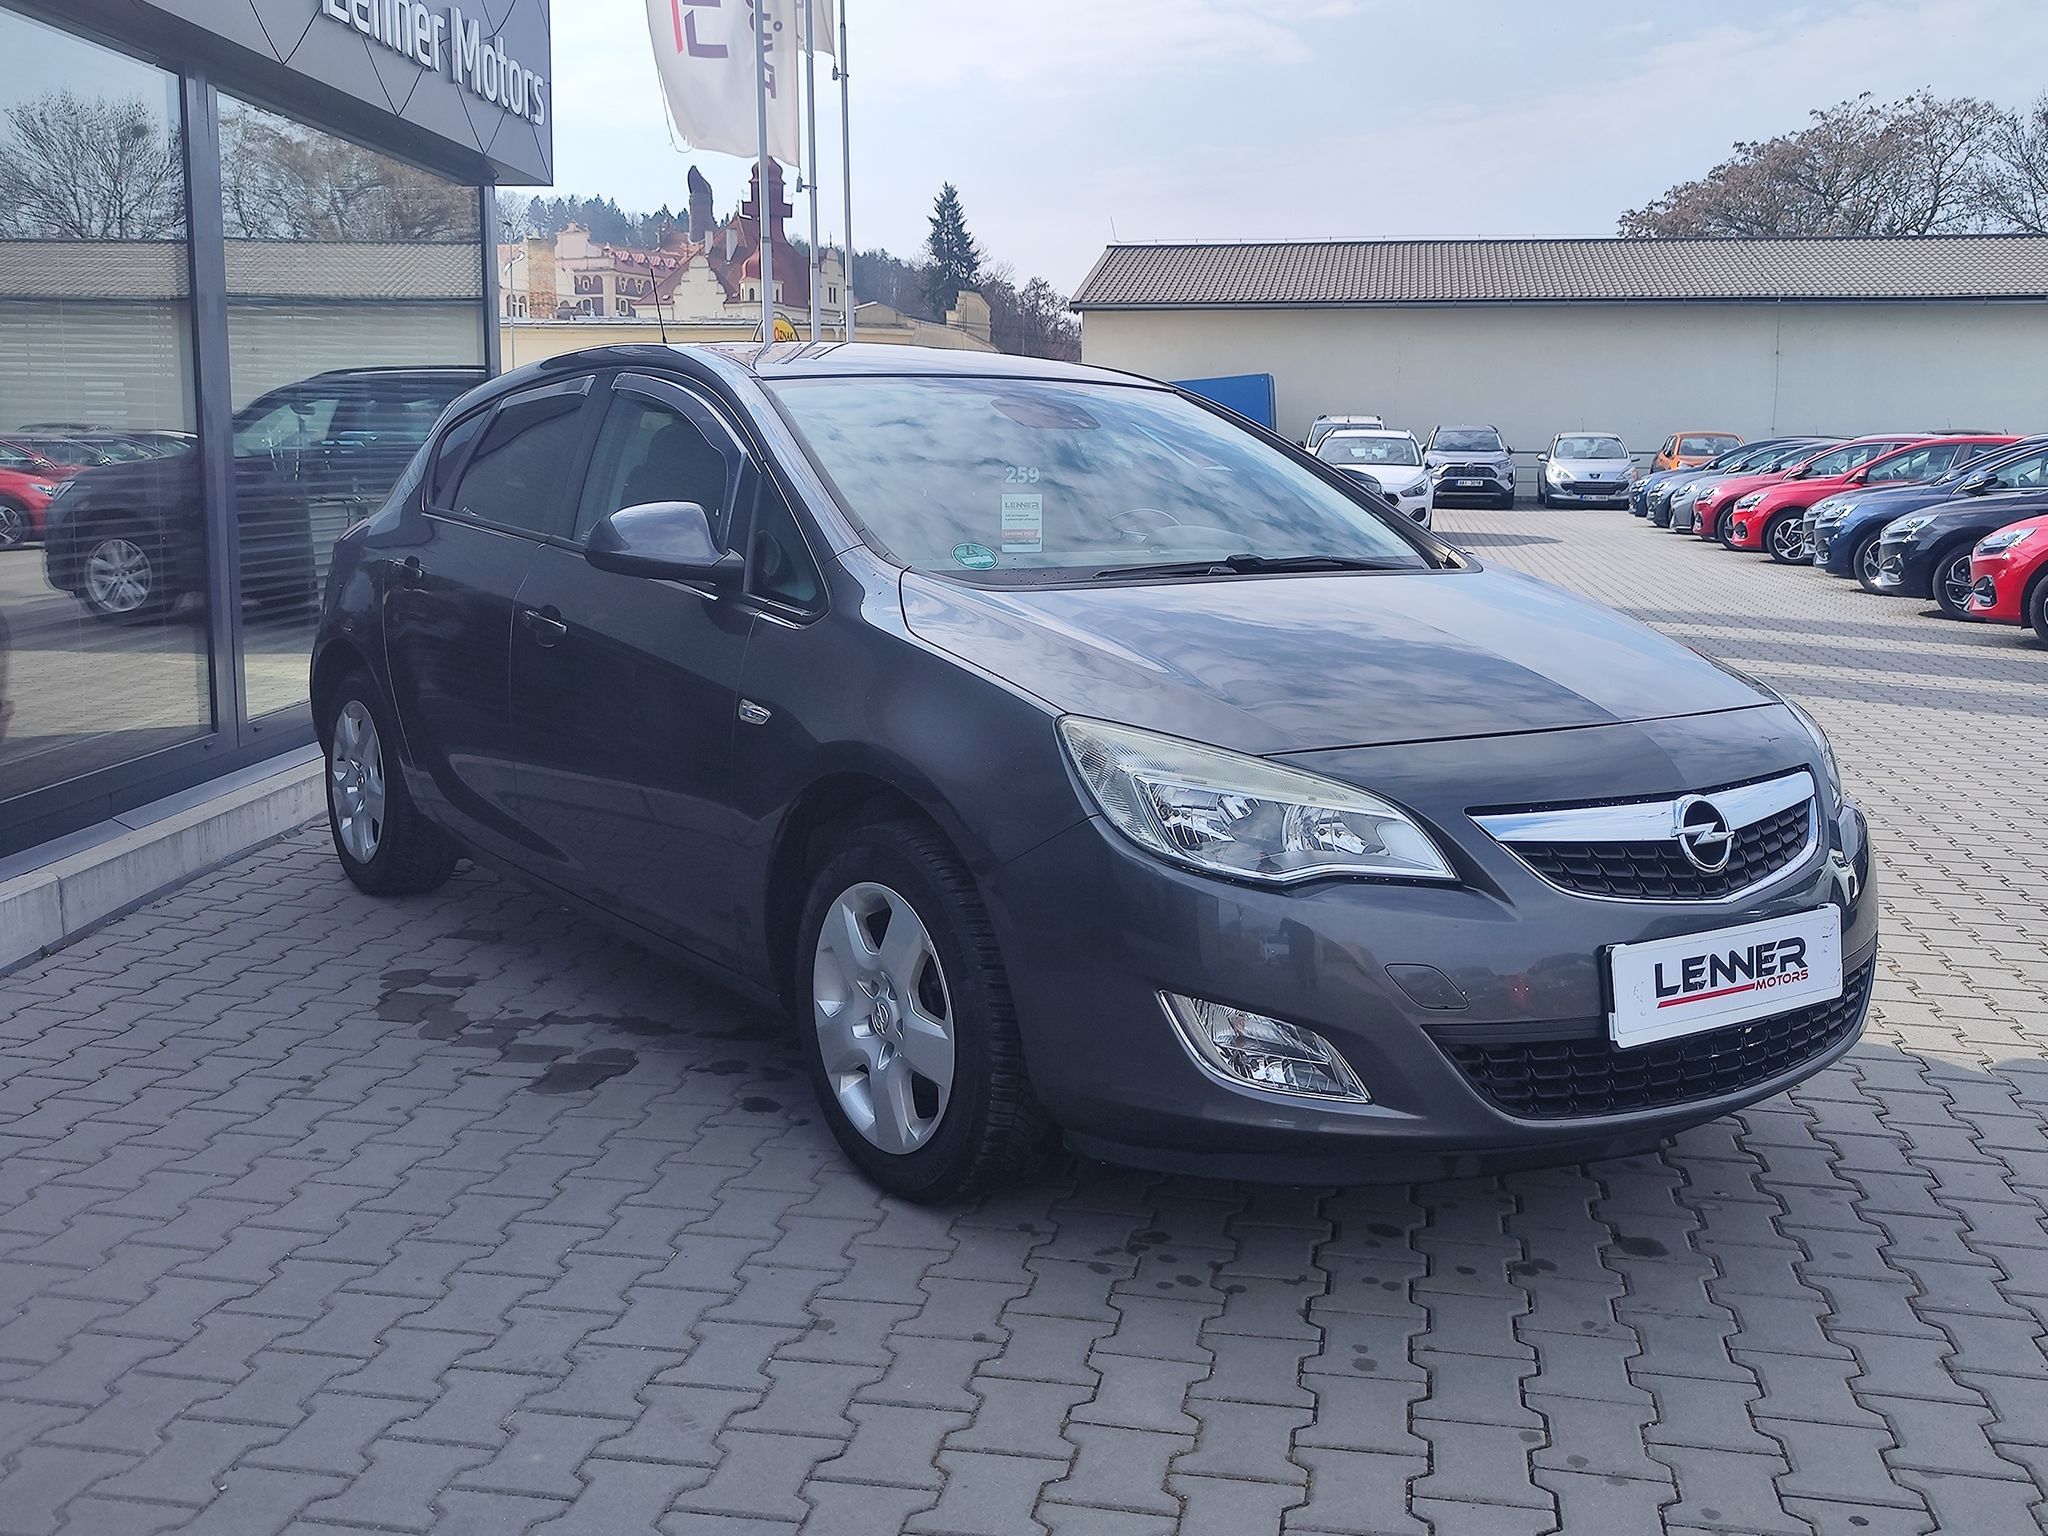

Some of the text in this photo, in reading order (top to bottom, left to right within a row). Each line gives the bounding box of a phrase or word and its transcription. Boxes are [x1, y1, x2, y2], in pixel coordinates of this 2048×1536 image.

[451, 6, 546, 126] Motors
[1004, 466, 1040, 484] 259
[1005, 502, 1040, 510] LENNER
[1654, 937, 1808, 998] LENNER
[1755, 969, 1809, 991] MOTORS
